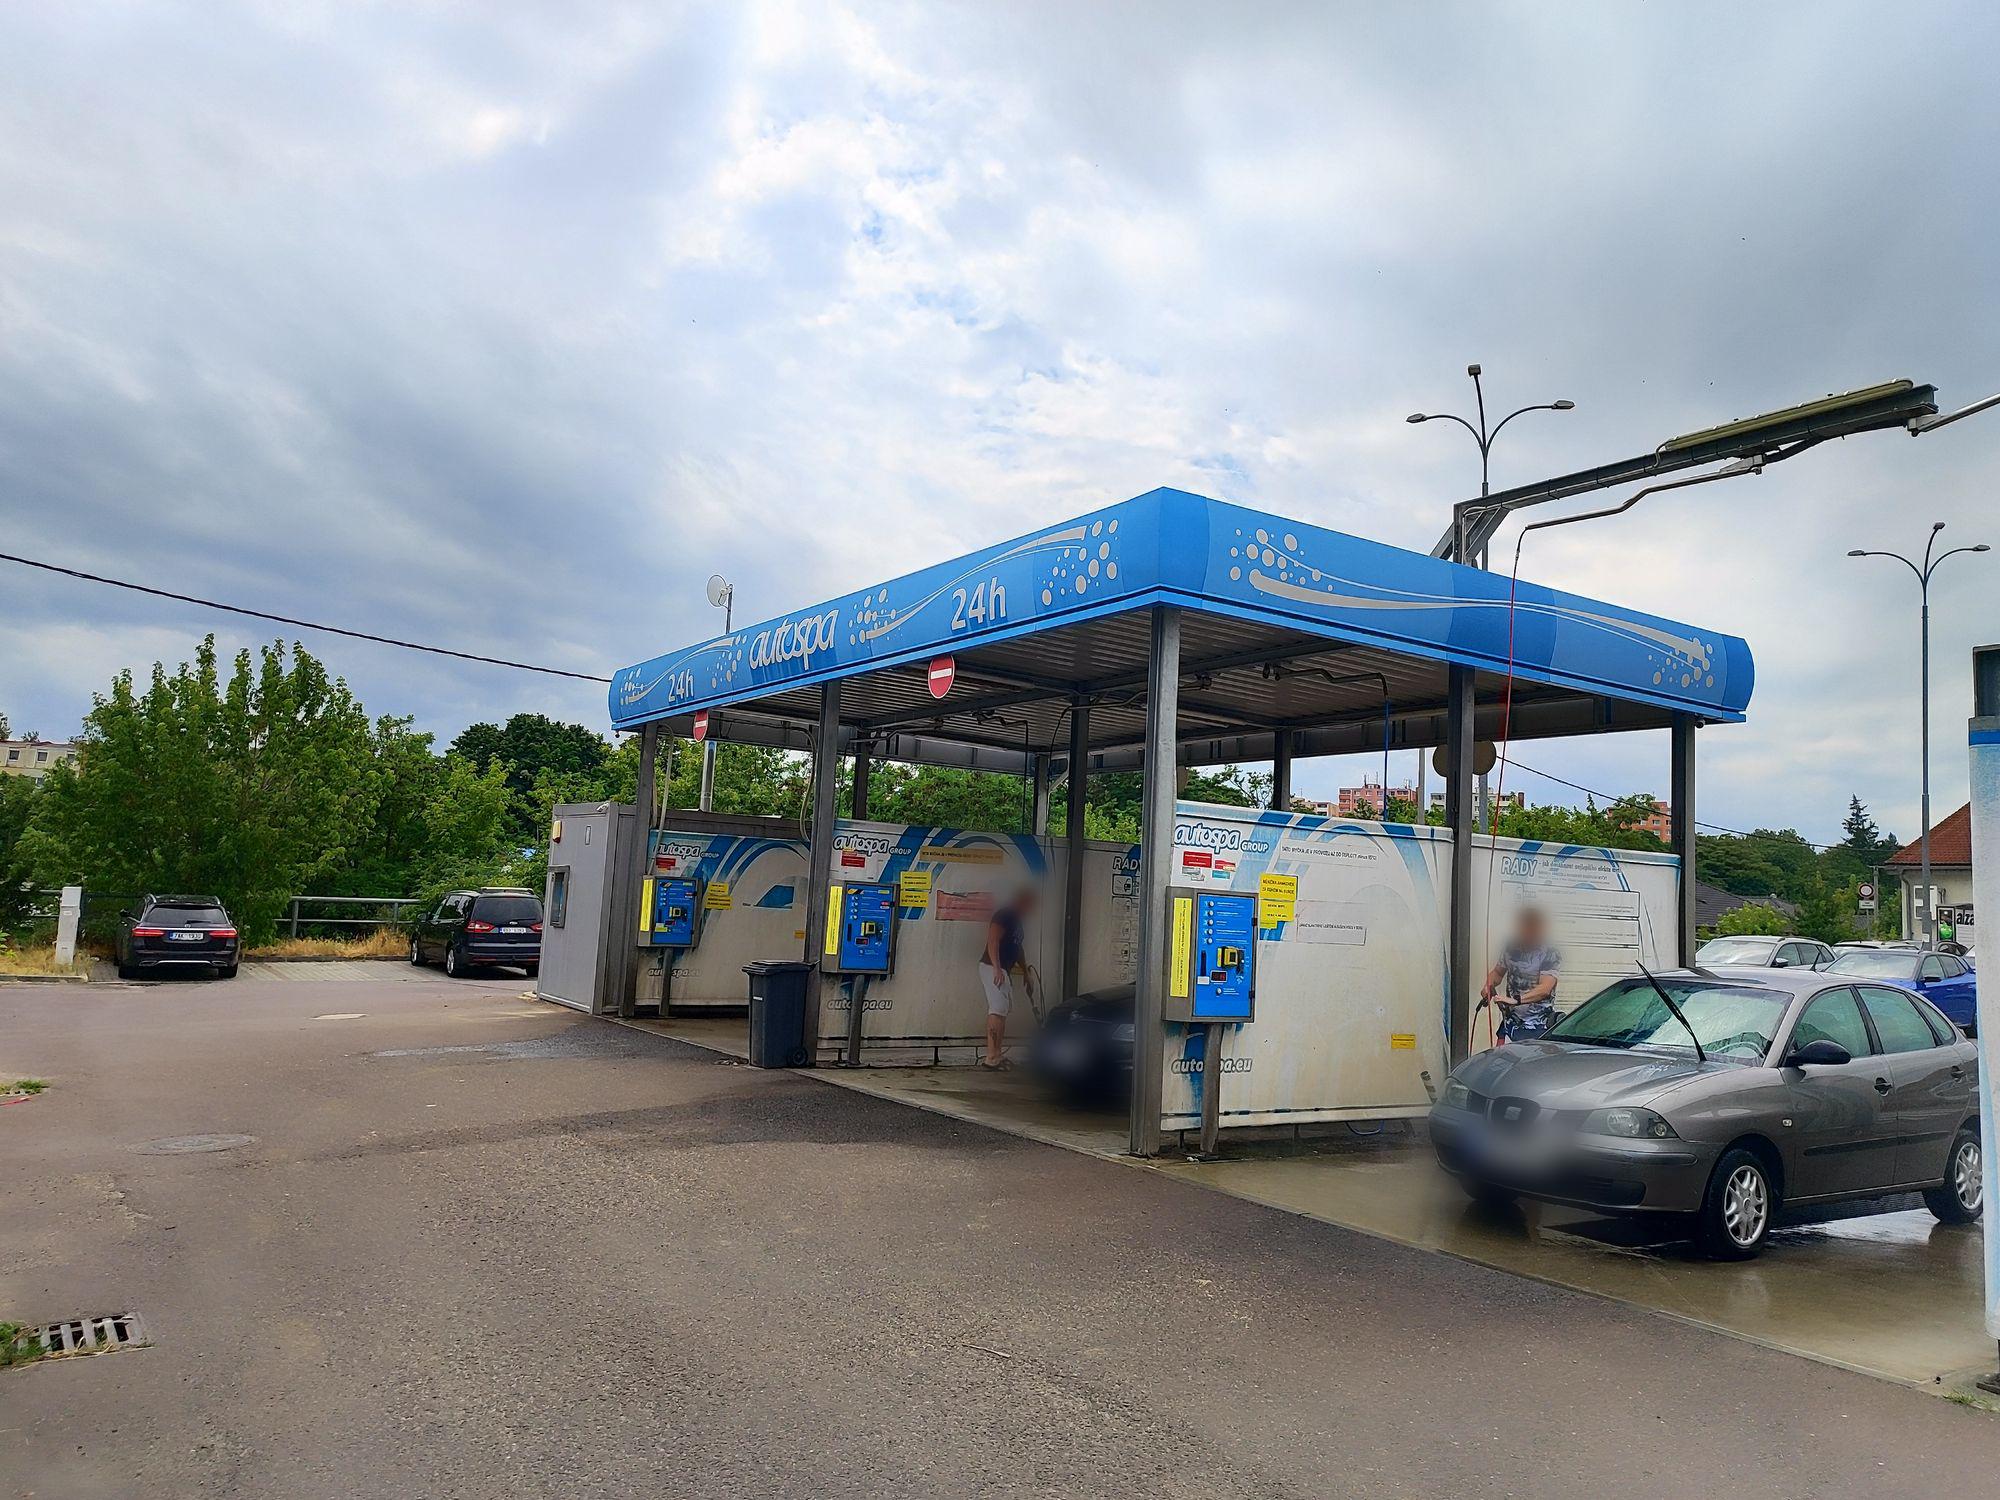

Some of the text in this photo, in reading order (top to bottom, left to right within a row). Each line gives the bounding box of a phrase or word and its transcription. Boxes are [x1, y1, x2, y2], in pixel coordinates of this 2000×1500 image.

[951, 576, 1008, 631] 24h
[748, 608, 840, 671] autospa
[668, 666, 695, 703] 24h
[833, 834, 912, 857] autospa GROUP
[1174, 822, 1270, 854] autospa GROUP
[1112, 856, 1141, 871] RAD
[1501, 856, 1538, 877] RADY
[647, 967, 703, 979] autspa.eu
[827, 997, 894, 1013] autopa.eu
[1171, 1058, 1253, 1075] autoa.eu
